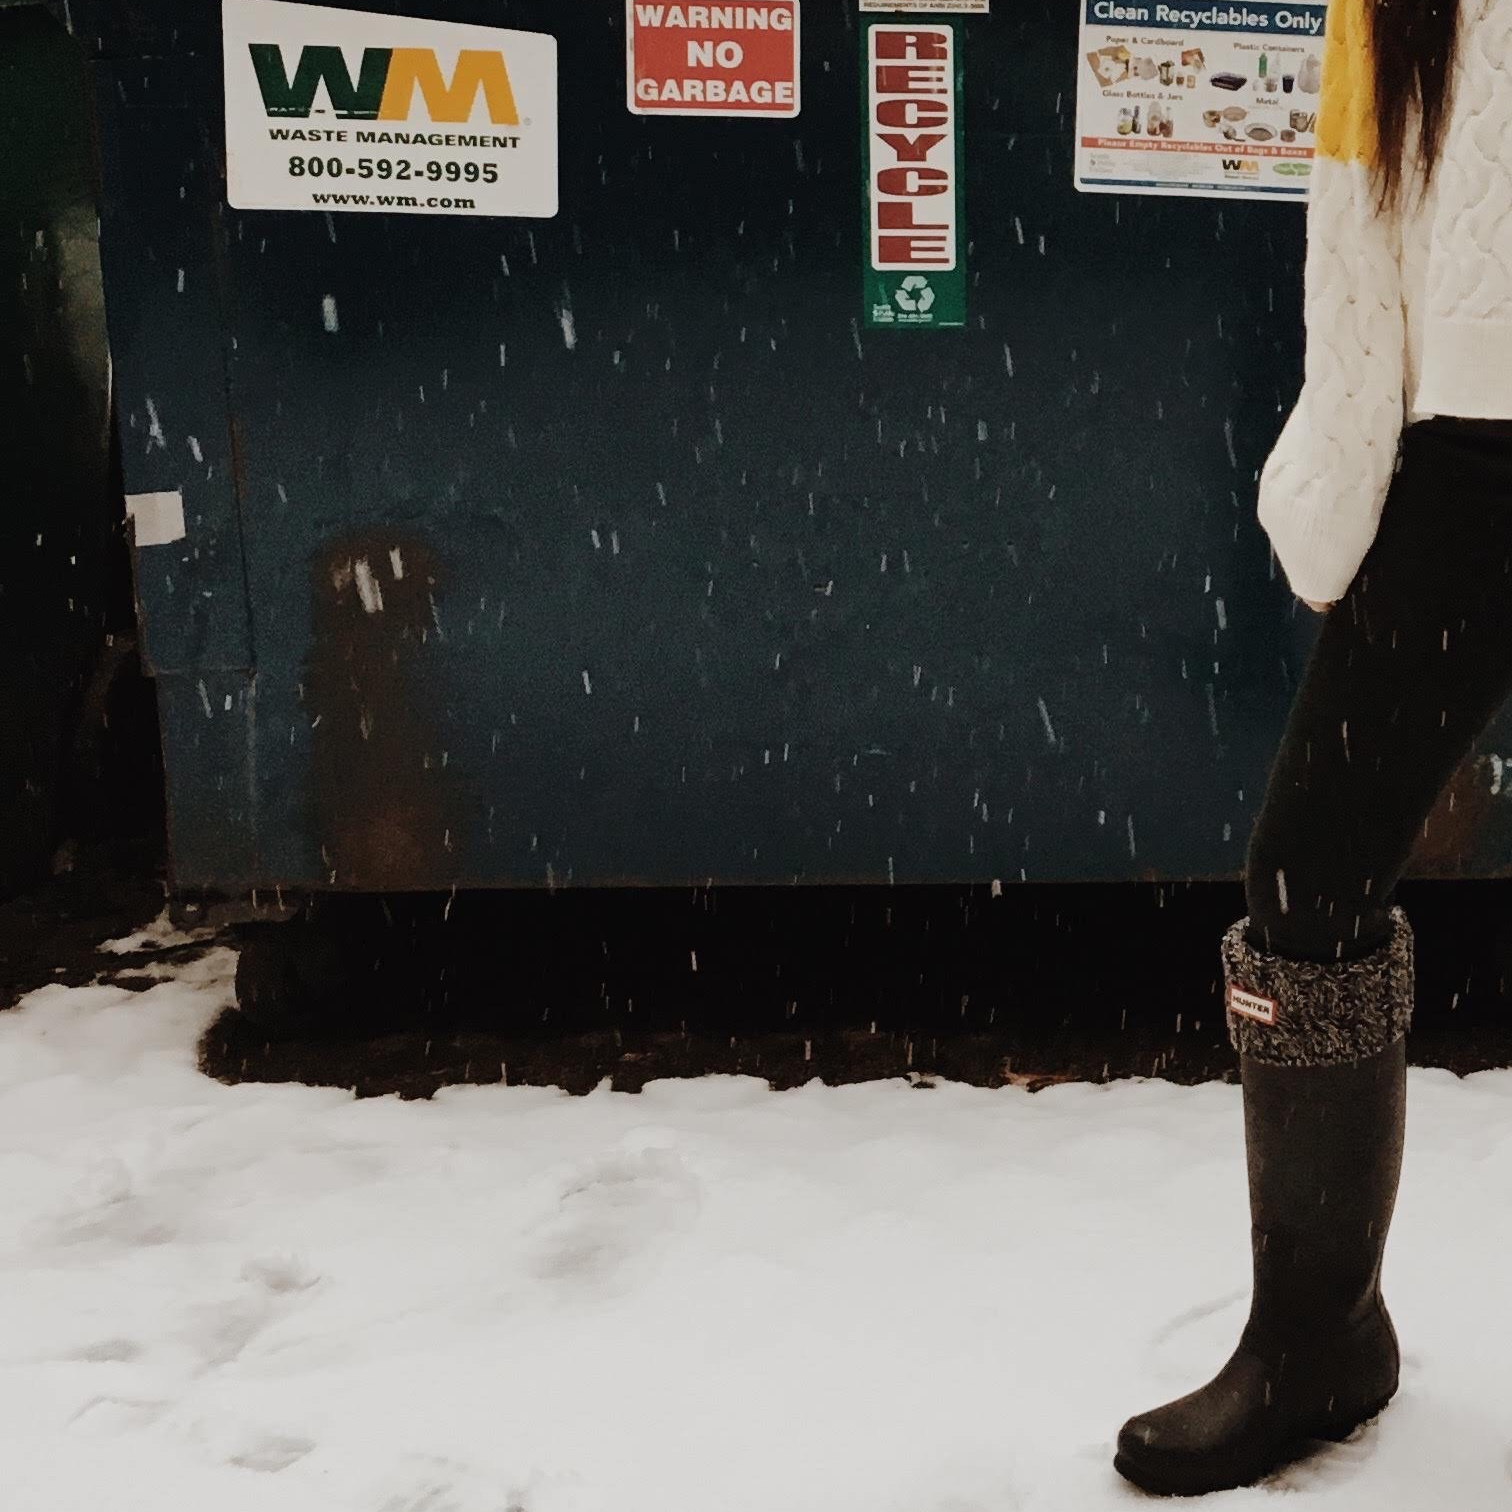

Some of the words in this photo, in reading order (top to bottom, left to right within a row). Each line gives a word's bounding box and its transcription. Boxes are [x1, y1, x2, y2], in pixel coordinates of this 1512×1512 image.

[635, 4, 792, 31] WARNING
[1093, 1, 1149, 21] Clean
[1156, 4, 1269, 29] Recyclables
[1275, 10, 1323, 35] Only
[1106, 35, 1129, 44] Paper
[1141, 37, 1184, 46] Cardboard
[1233, 42, 1259, 51] Plastic
[1262, 43, 1305, 53] Containers
[687, 40, 744, 68] NO
[248, 43, 519, 125] WM
[635, 79, 794, 104] GARBAGE
[1102, 90, 1124, 98] Glass
[1127, 91, 1155, 100] Bottles
[1256, 97, 1279, 105] Metal
[268, 128, 348, 143] WASTE
[355, 131, 521, 149] MANAGEMENT
[875, 31, 950, 264] RECYCLE
[288, 156, 499, 184] 800-592-9995
[1222, 159, 1259, 172] WM
[311, 192, 476, 209] www.wm.com
[1232, 995, 1270, 1014] HUNTER
